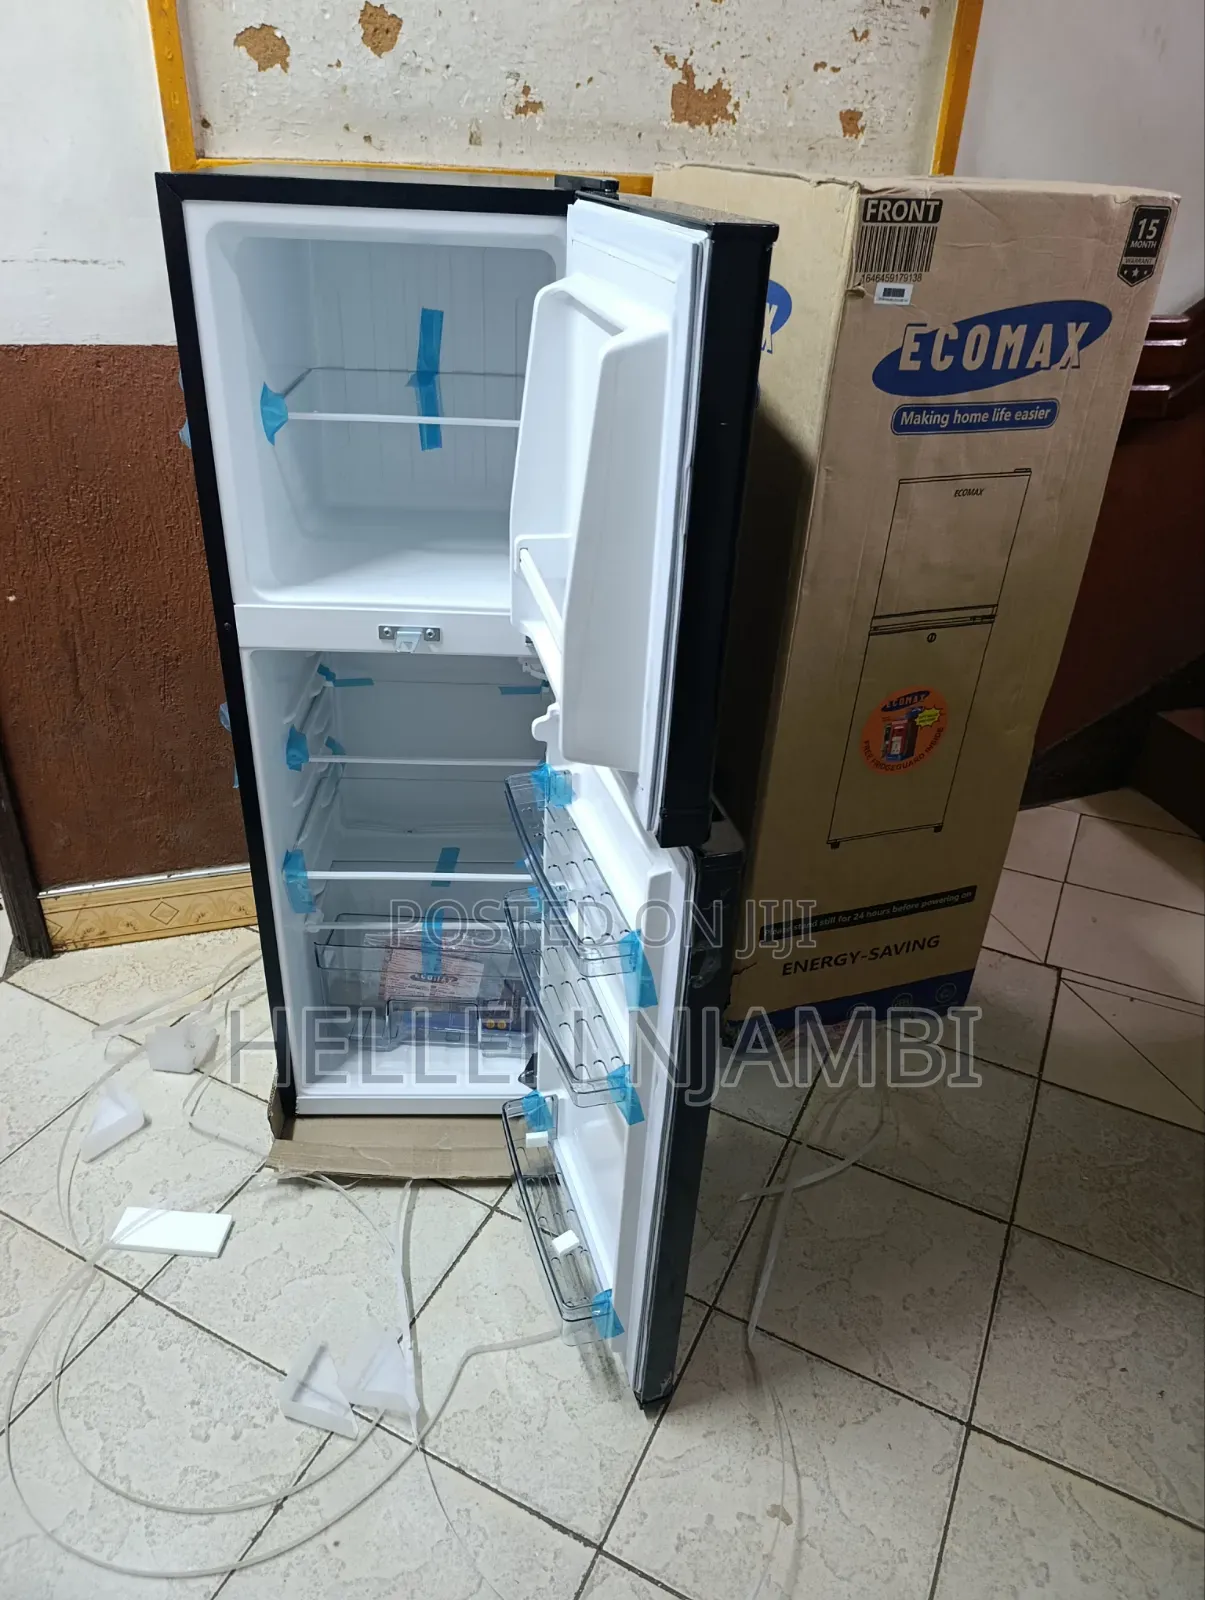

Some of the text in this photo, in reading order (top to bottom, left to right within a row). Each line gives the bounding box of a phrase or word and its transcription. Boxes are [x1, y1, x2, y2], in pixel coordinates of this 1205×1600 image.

[865, 199, 940, 222] FRONT
[1137, 218, 1160, 240] 15
[1130, 240, 1157, 249] MONTH
[861, 273, 923, 283] 1646459179138
[898, 320, 1091, 372] ECOMAX
[900, 405, 1051, 428] Making home life easier
[953, 487, 985, 497] ECOMAX
[924, 726, 944, 754] INSIDE
[819, 915, 836, 927] still
[838, 914, 851, 924] for
[852, 912, 864, 921] 24
[866, 908, 890, 918] hours
[891, 902, 919, 914] before
[920, 894, 960, 909] powering
[960, 890, 972, 899] on
[781, 934, 941, 976] ENERGY-SAVING
